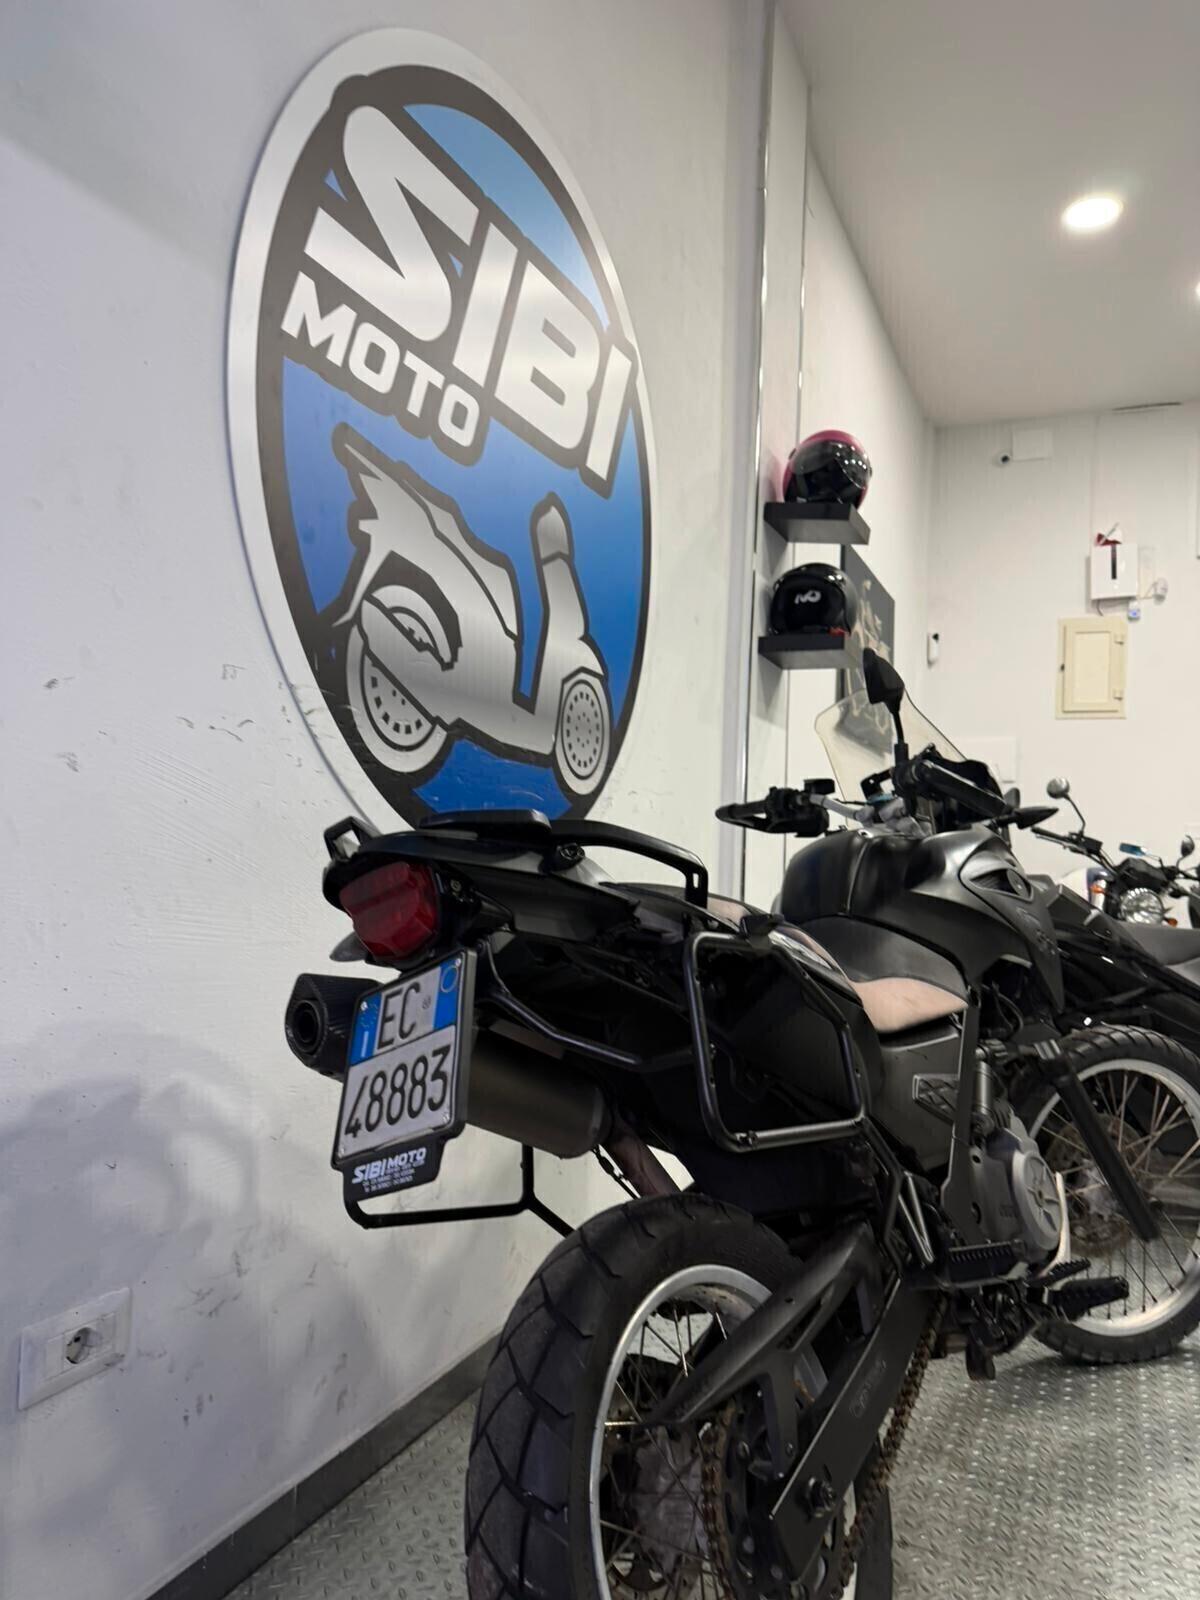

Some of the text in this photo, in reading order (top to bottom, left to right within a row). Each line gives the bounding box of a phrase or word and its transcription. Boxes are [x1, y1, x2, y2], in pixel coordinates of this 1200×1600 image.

[304, 105, 632, 481] SIBI
[280, 271, 480, 447] MOTO
[377, 981, 421, 1049] EC
[344, 1044, 452, 1138] 48883
[351, 1158, 387, 1184] SIBI
[387, 1147, 427, 1169] MOTO
